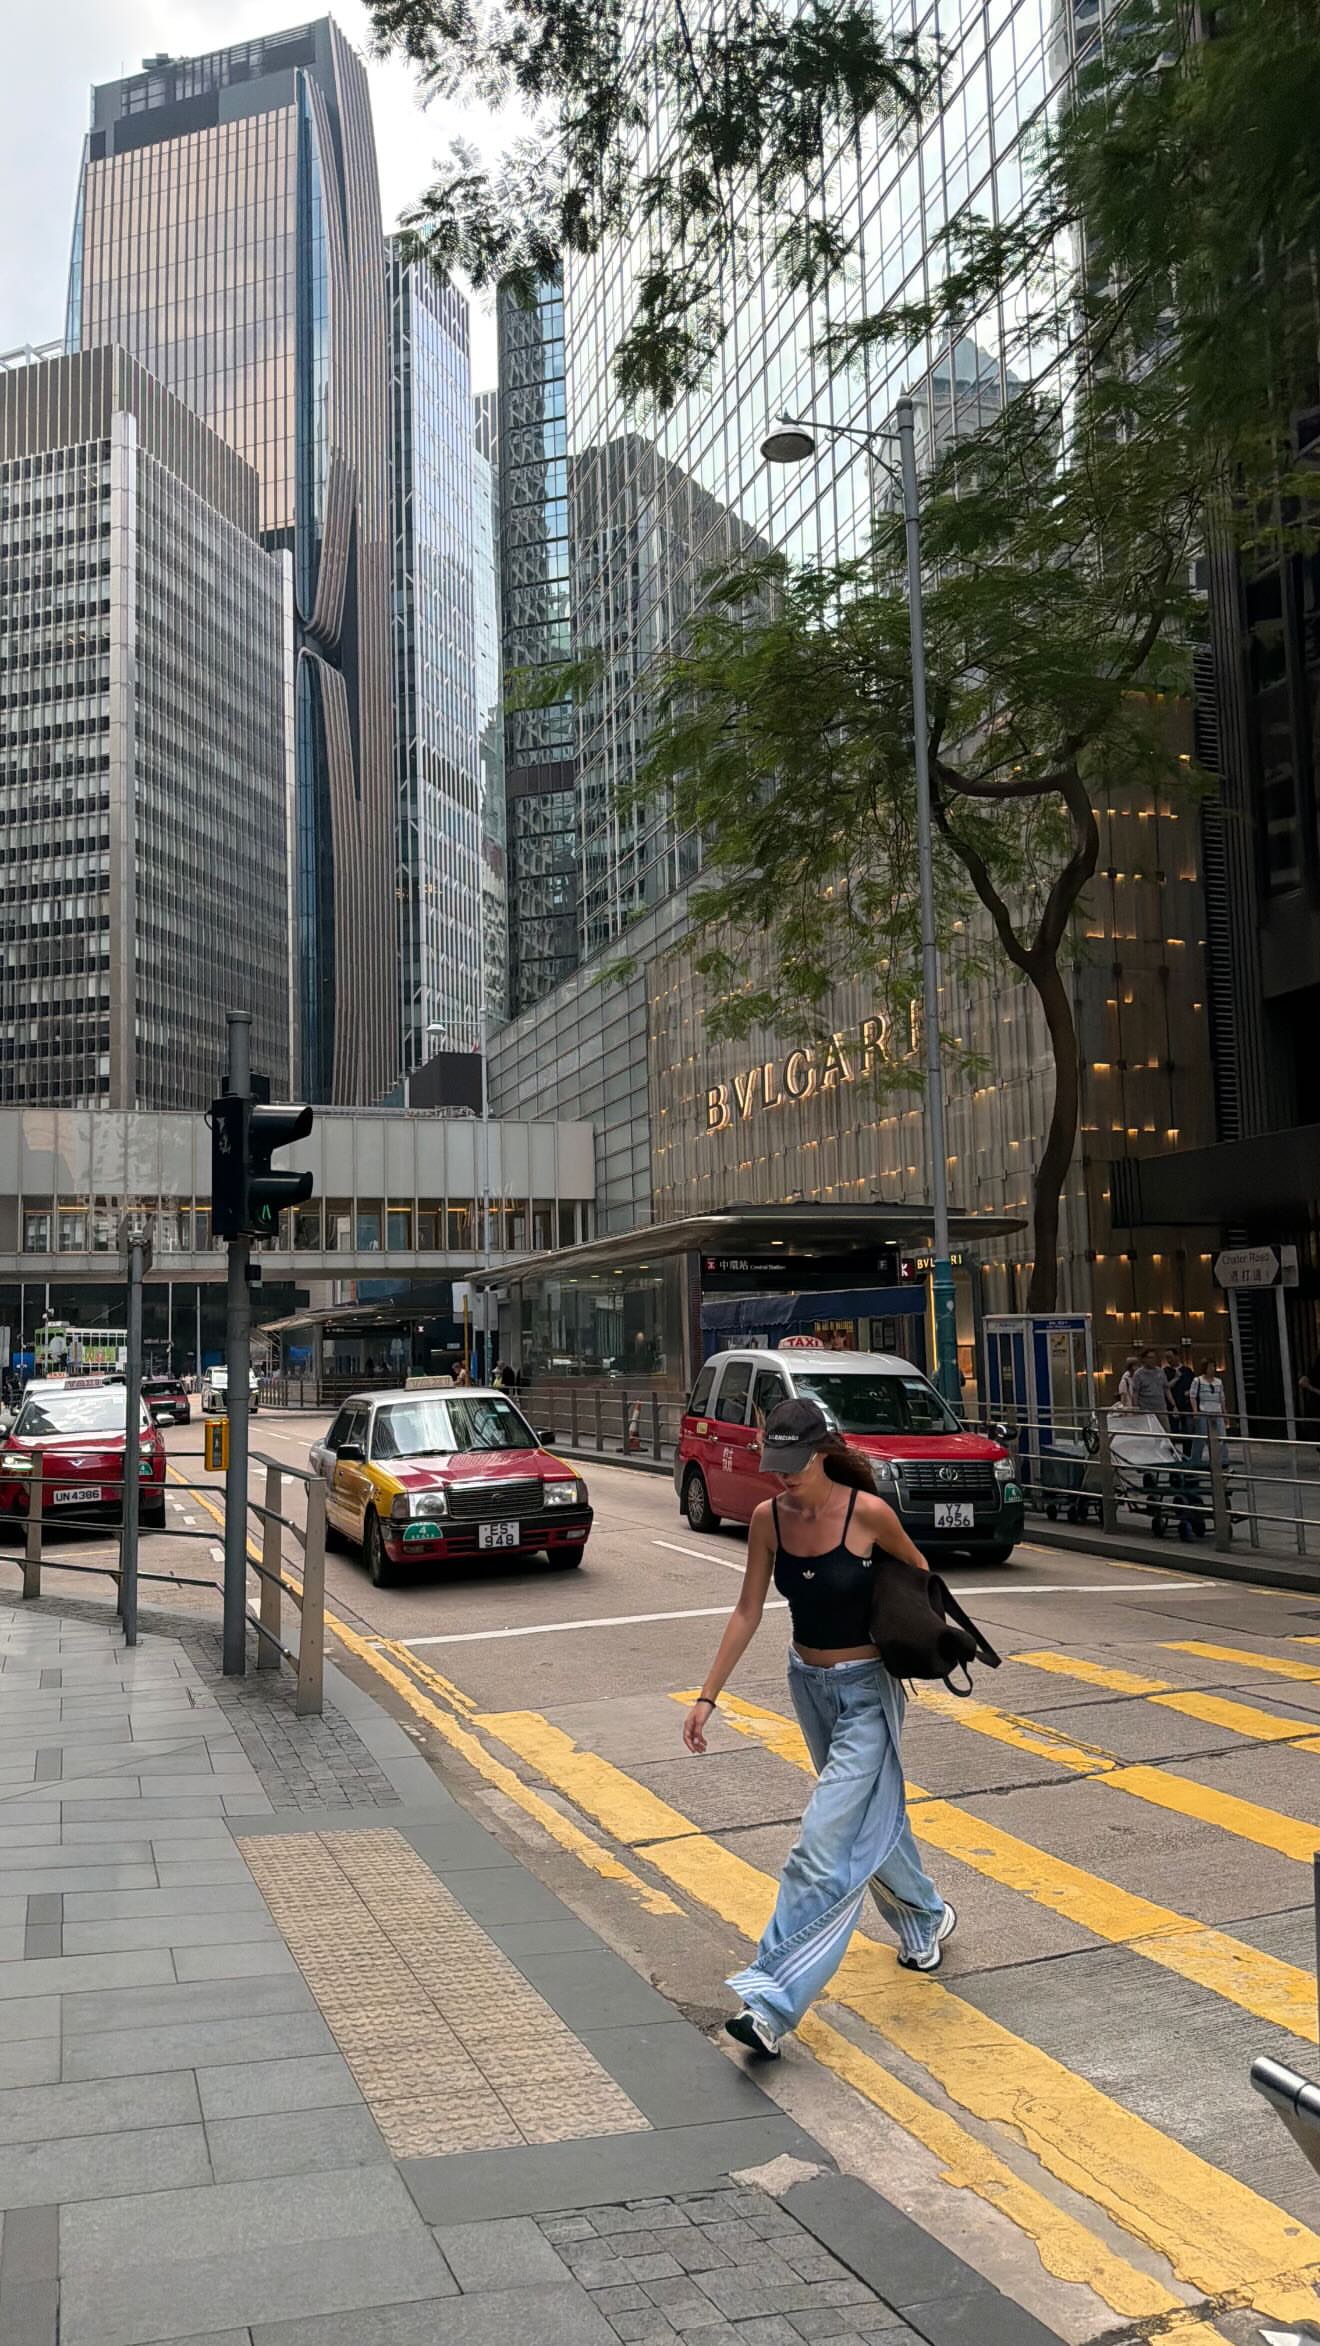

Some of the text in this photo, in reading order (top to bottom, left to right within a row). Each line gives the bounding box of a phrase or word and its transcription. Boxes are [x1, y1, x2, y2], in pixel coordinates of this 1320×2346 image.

[705, 999, 924, 1136] BVLGARI
[916, 1253, 963, 1270] BVLRI
[787, 1338, 820, 1347] TAXI
[56, 1489, 100, 1502] UN 4386
[946, 1503, 962, 1515] YZ
[937, 1514, 971, 1528] 4956
[418, 1526, 427, 1534] 4
[489, 1523, 509, 1536] ES
[484, 1534, 515, 1548] 948
